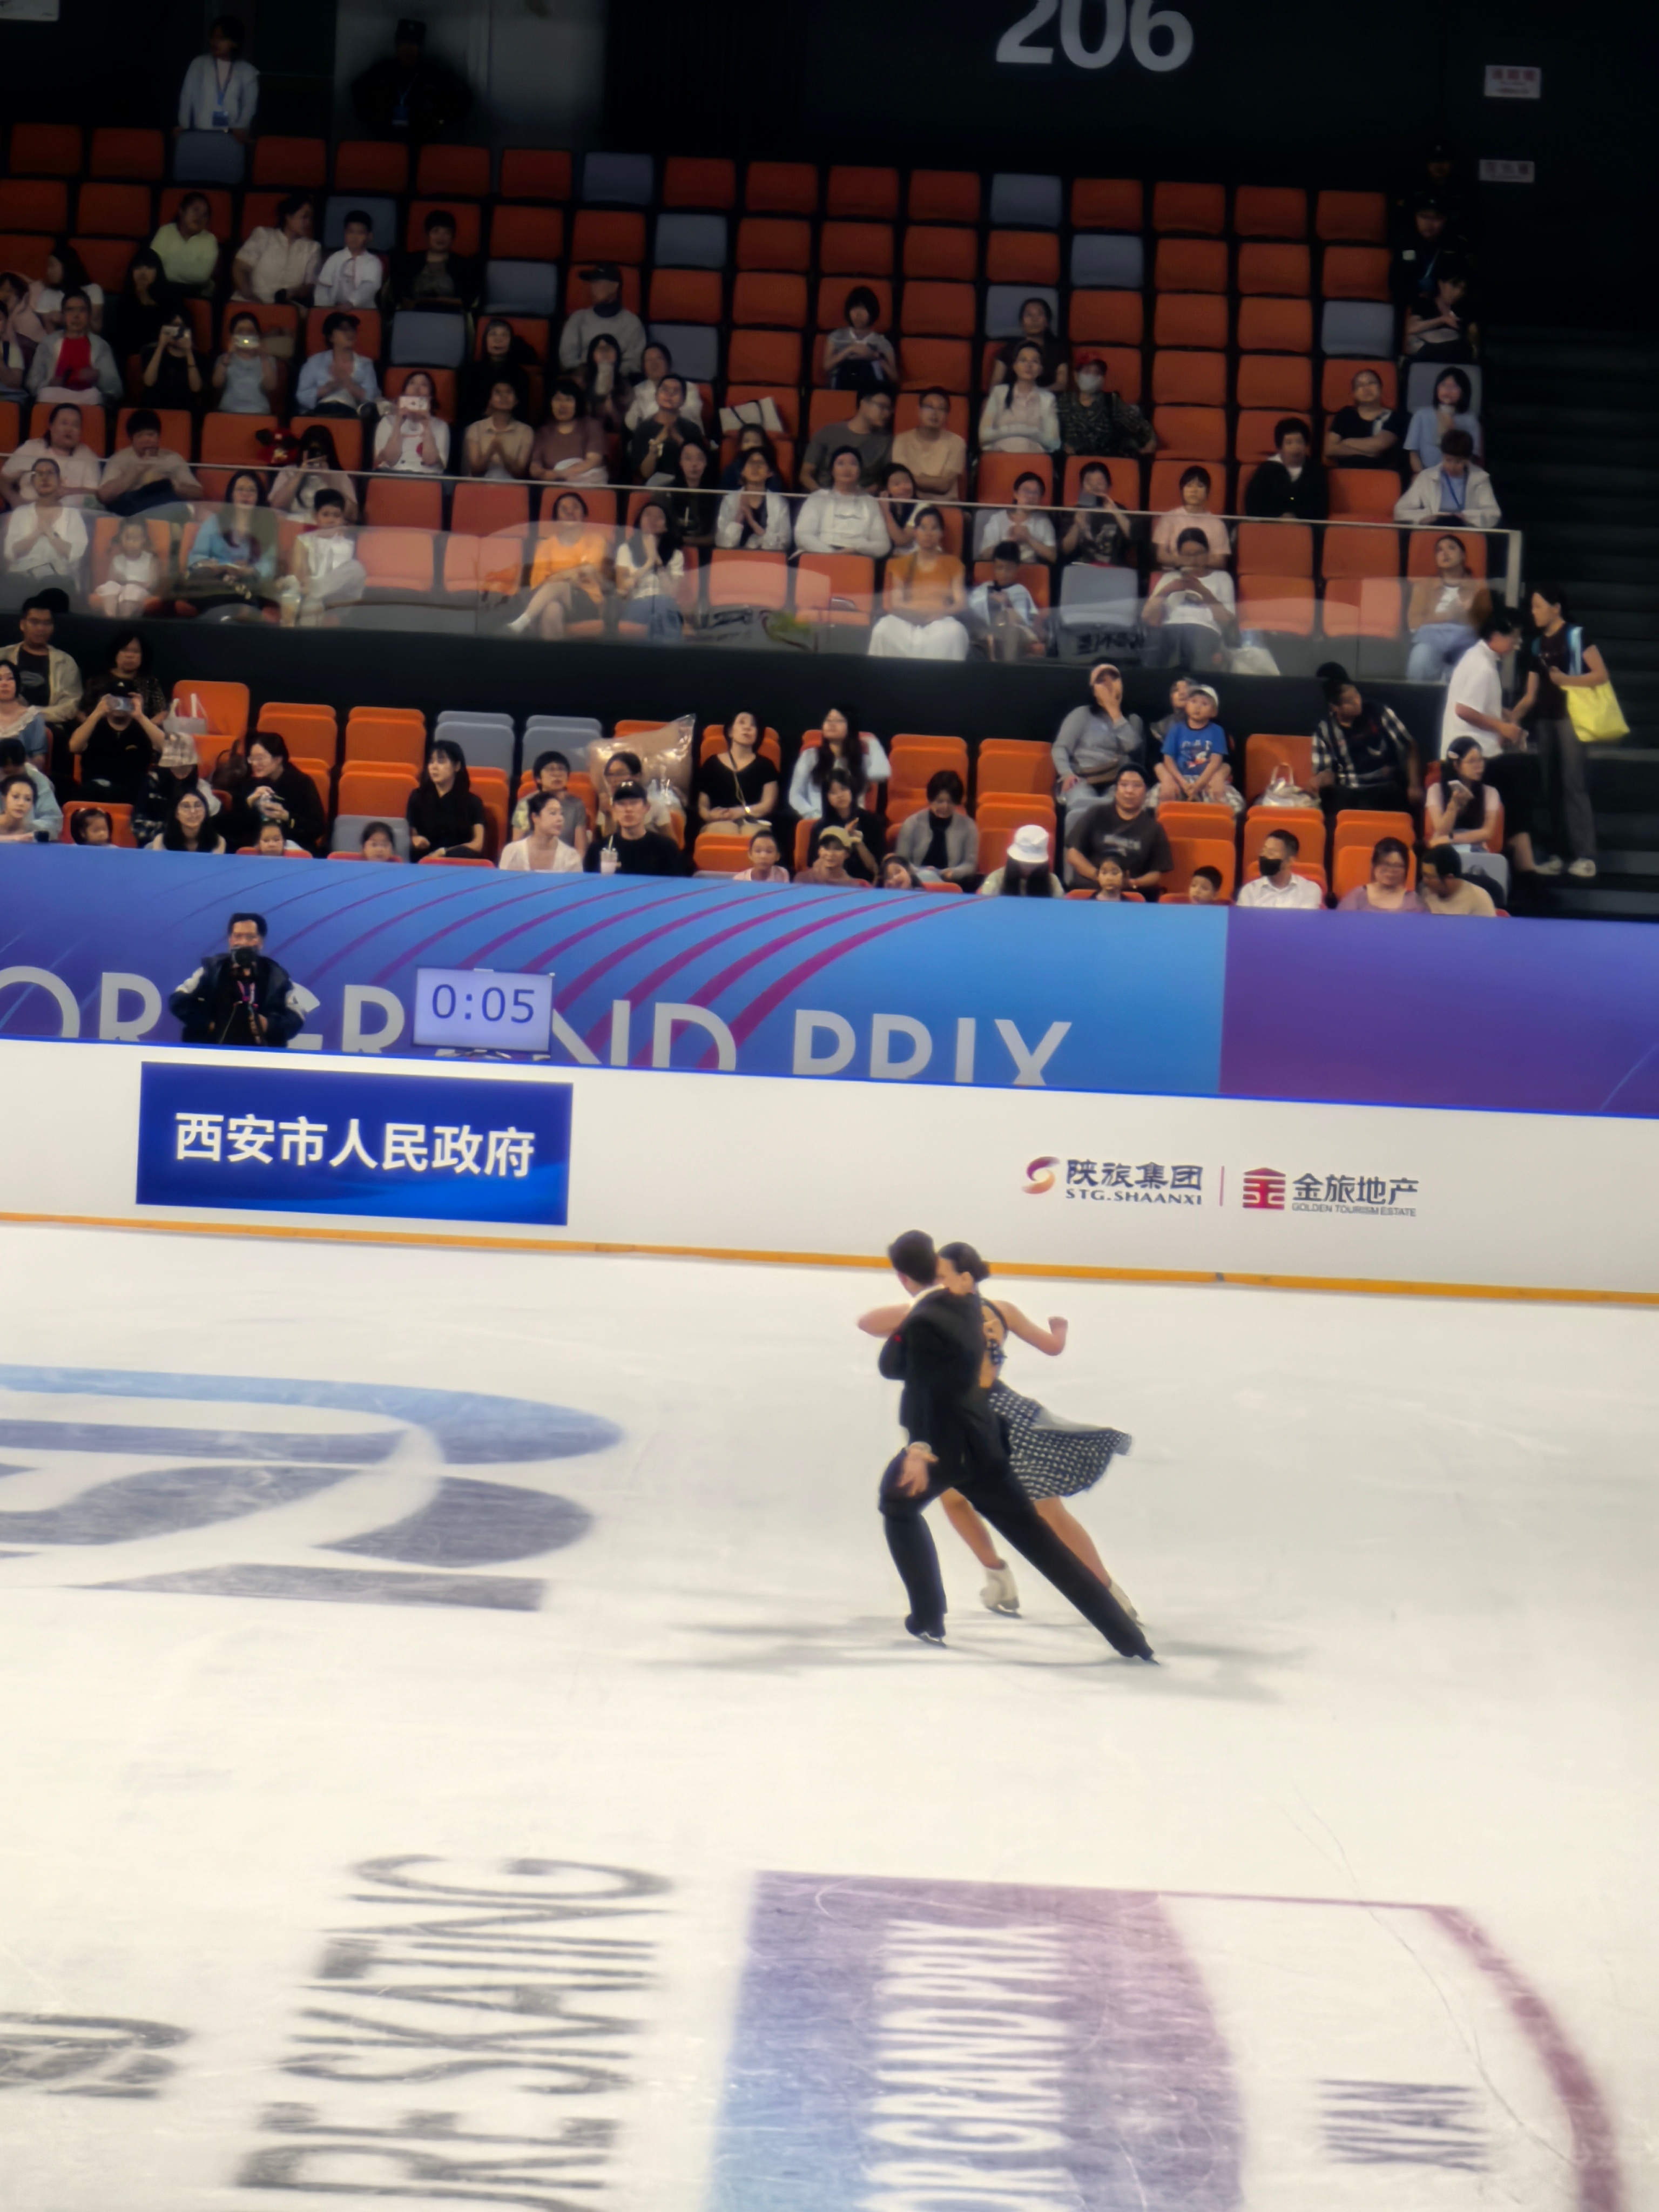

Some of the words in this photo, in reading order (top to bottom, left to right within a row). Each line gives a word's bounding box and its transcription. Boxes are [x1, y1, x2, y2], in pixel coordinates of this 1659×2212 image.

[996, 0, 1194, 71] 206
[433, 984, 535, 1023] 0:05
[175, 1112, 535, 1177] 西安市人民政府
[1065, 1188, 1202, 1206] STG.SHAANXI
[1066, 1158, 1203, 1191] 陕旅集团
[1292, 1173, 1419, 1205] 金旅地产
[1292, 1202, 1332, 1213] GOLDEN
[278, 1853, 675, 2096] SKATING
[874, 1918, 1074, 2002] PRIX
[865, 2008, 1074, 2152] GRAND
